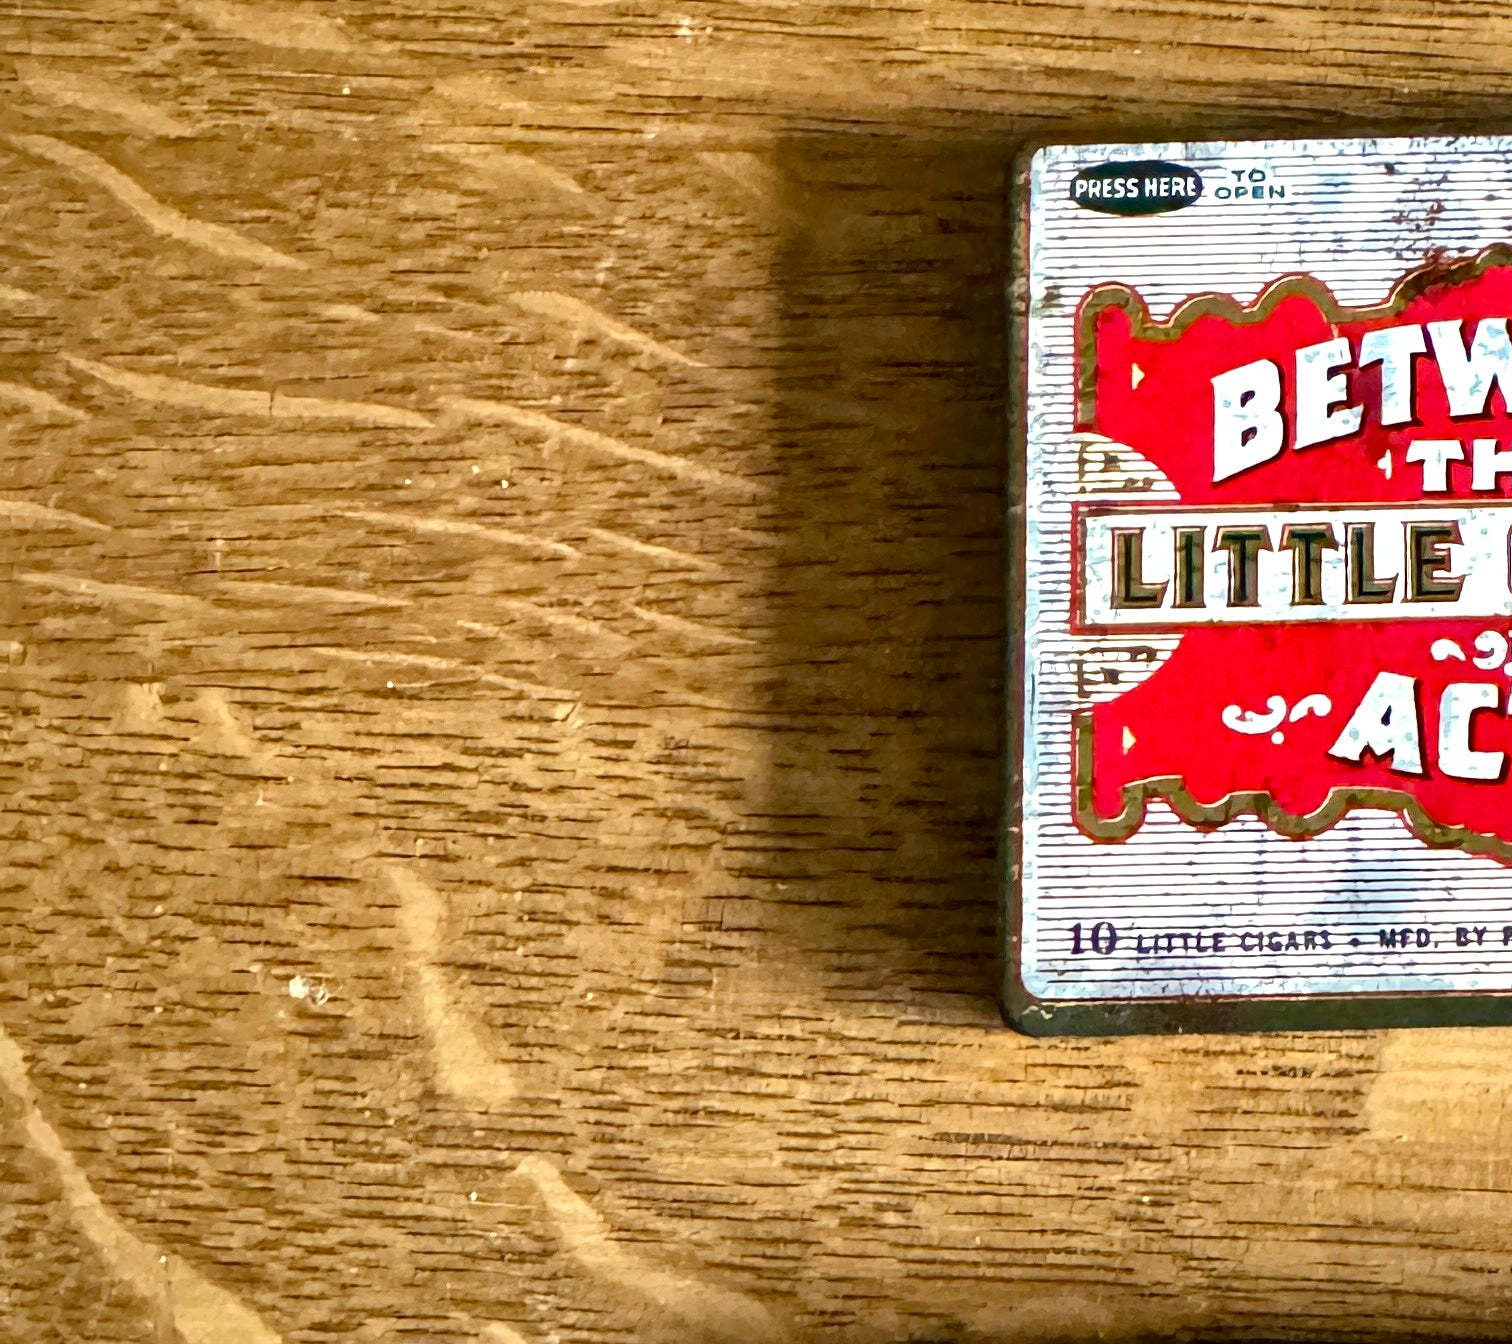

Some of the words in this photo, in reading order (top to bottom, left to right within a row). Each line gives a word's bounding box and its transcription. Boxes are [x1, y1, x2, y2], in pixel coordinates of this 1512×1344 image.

[1074, 177, 1140, 199] PRESS
[1144, 176, 1197, 198] HERE
[1230, 169, 1267, 183] TO
[1213, 185, 1286, 200] OPEN
[1109, 516, 1466, 610] LITTLE
[1069, 922, 1118, 955] 10
[1135, 933, 1226, 954] LITTLE
[1239, 930, 1332, 952] CIGARS
[1378, 928, 1440, 949] MFD.
[1454, 926, 1488, 947] BY
